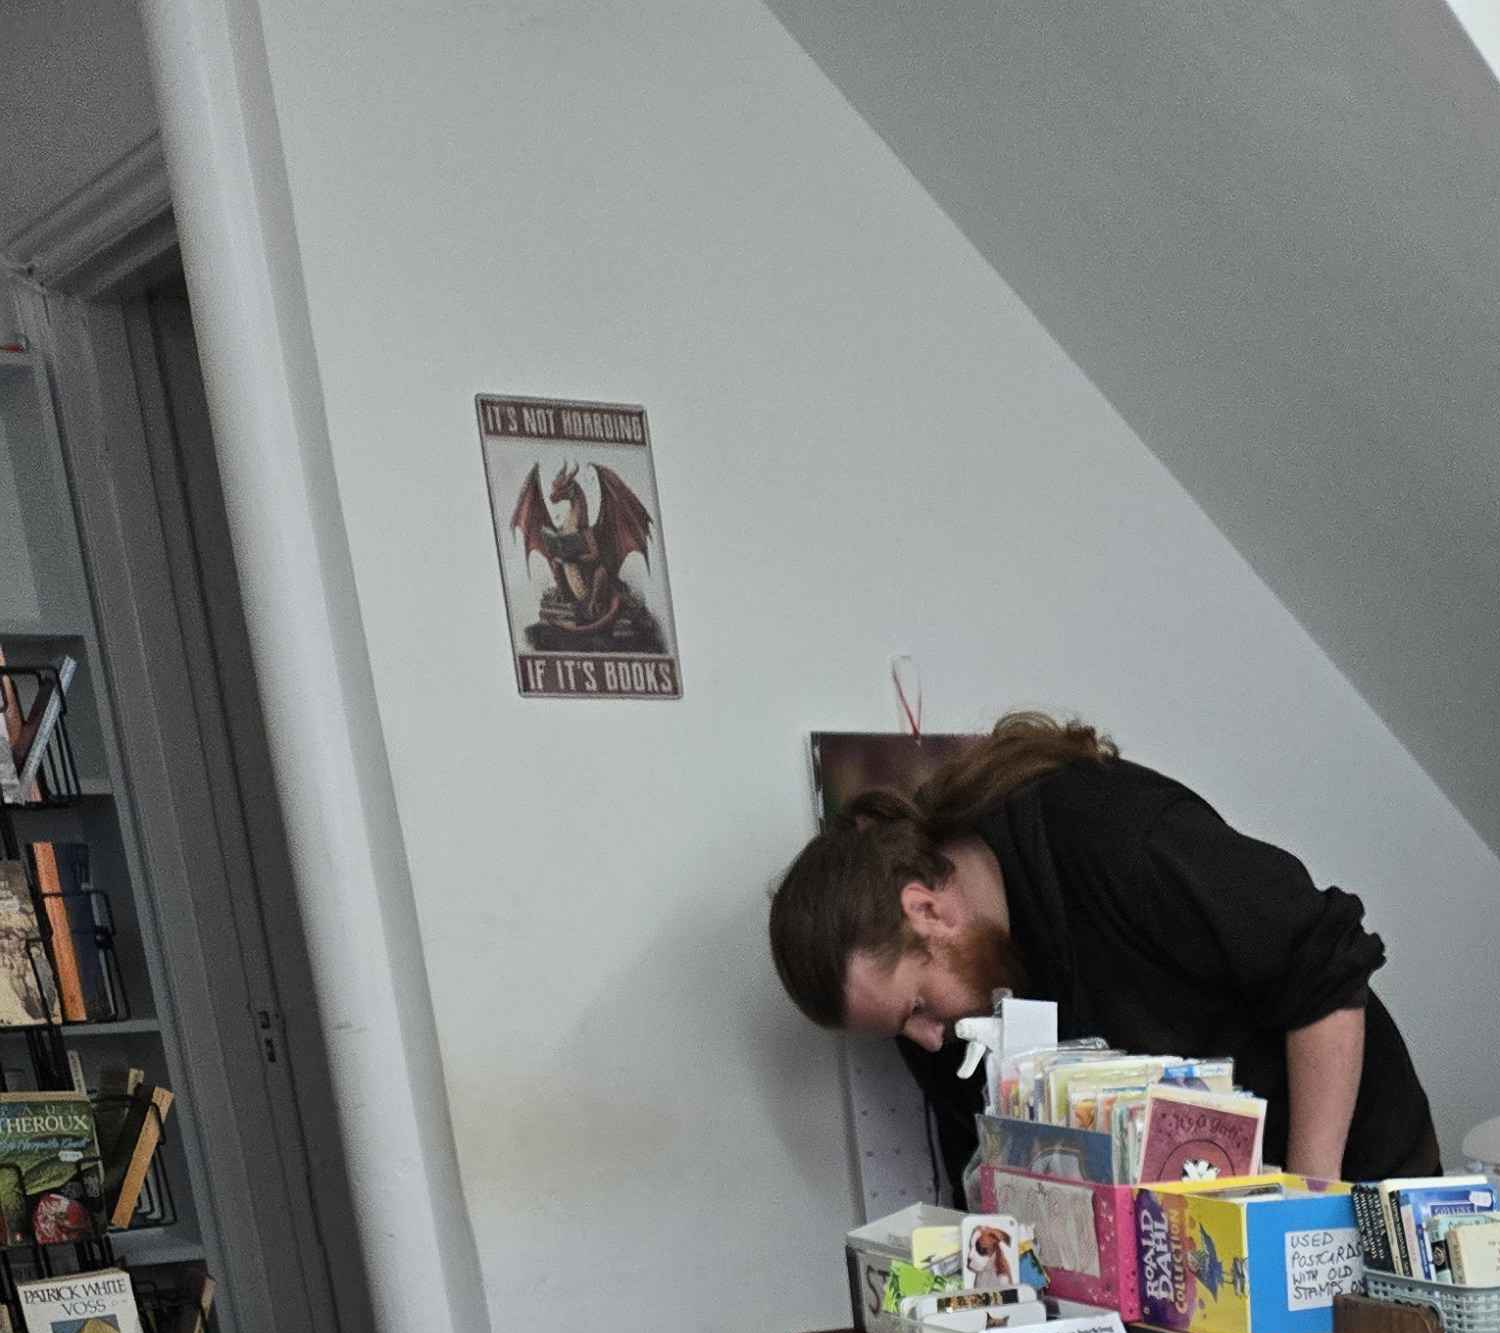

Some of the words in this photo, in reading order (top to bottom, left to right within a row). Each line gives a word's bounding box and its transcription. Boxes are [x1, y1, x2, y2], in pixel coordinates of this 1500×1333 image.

[485, 404, 518, 433] IT'S
[523, 408, 556, 435] NOT
[525, 659, 546, 691] IF
[555, 660, 596, 692] IT'S
[604, 661, 673, 693] BOOKS
[1289, 1231, 1334, 1249] USED
[1293, 1267, 1320, 1284] WITH
[1325, 1264, 1353, 1280] OLD
[23, 1284, 81, 1306] PATRICK
[61, 1299, 107, 1318] VOSS
